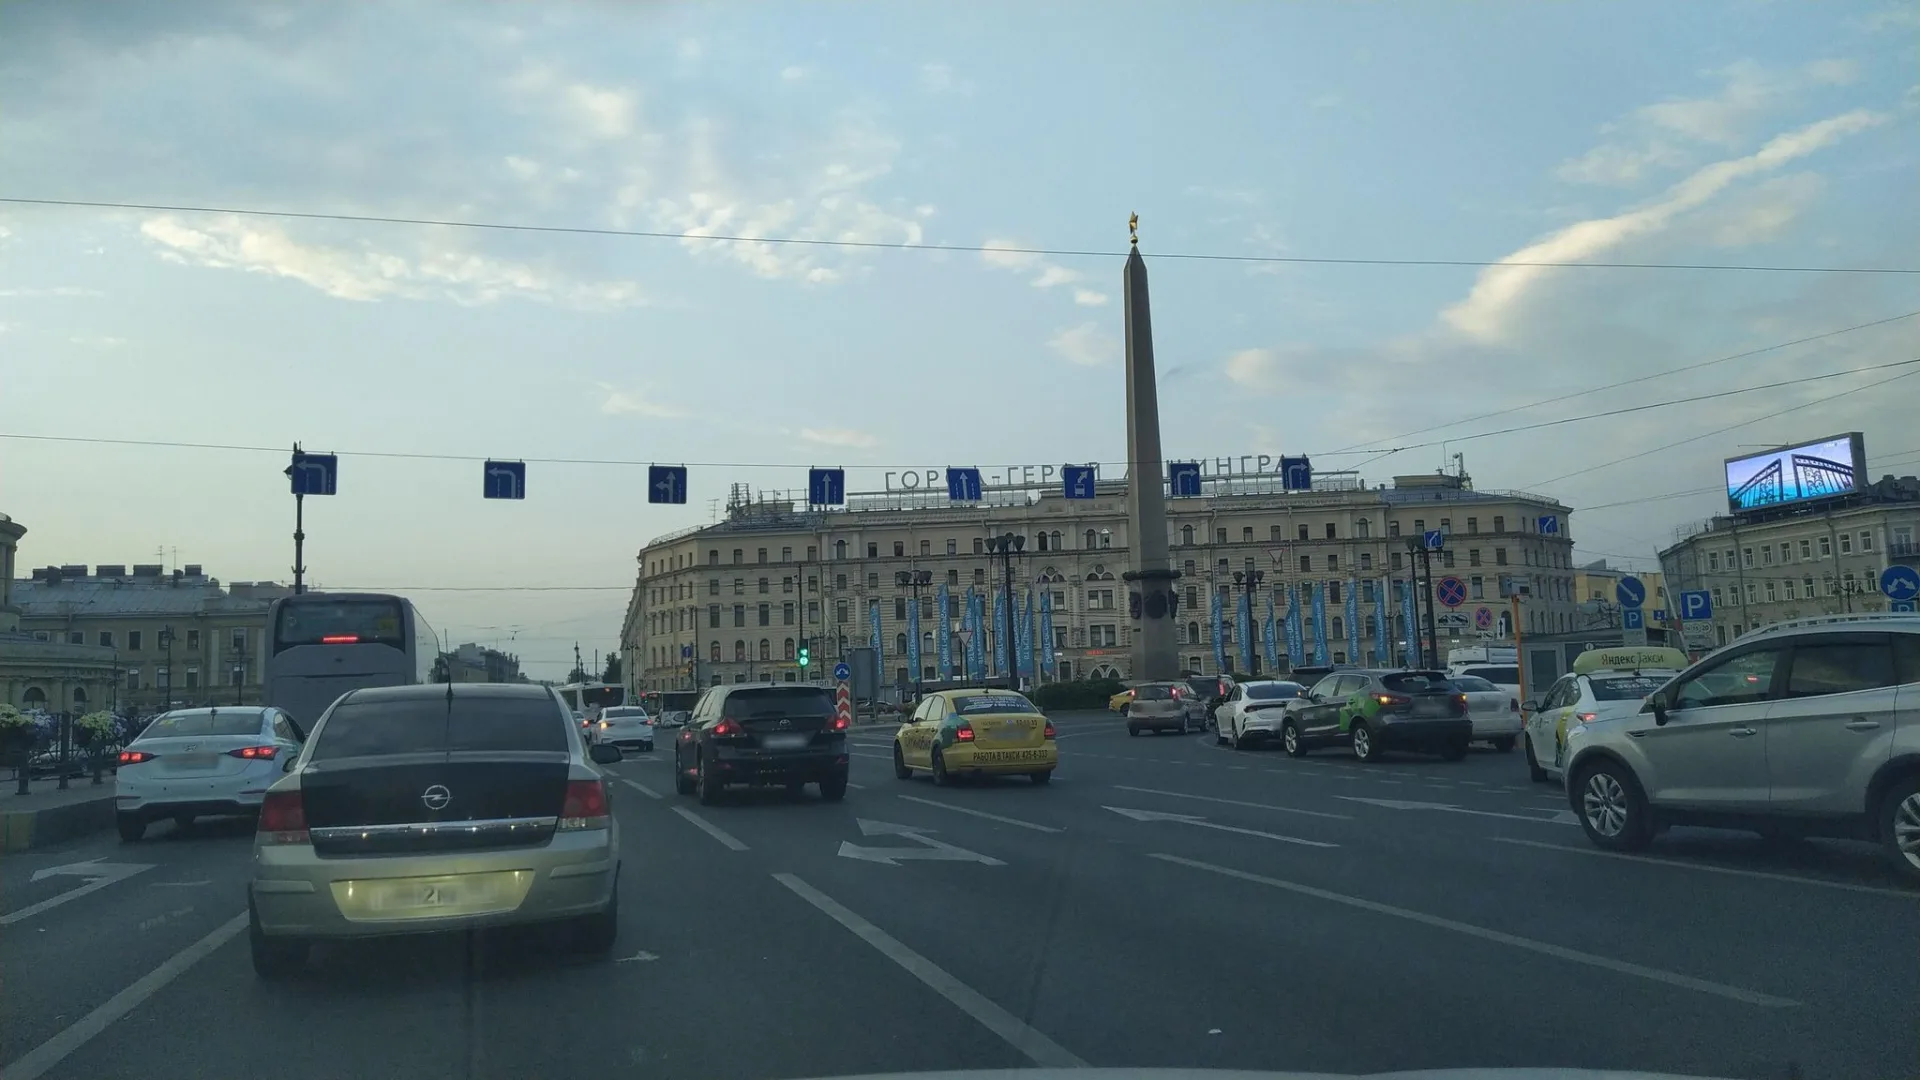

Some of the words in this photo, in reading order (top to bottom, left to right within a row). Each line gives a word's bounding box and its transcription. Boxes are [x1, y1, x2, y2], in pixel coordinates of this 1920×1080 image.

[1602, 653, 1636, 665] Яндекс
[1637, 652, 1664, 663] Такси
[973, 751, 996, 761] РАБОТА
[1002, 751, 1020, 760] ТАКСИ
